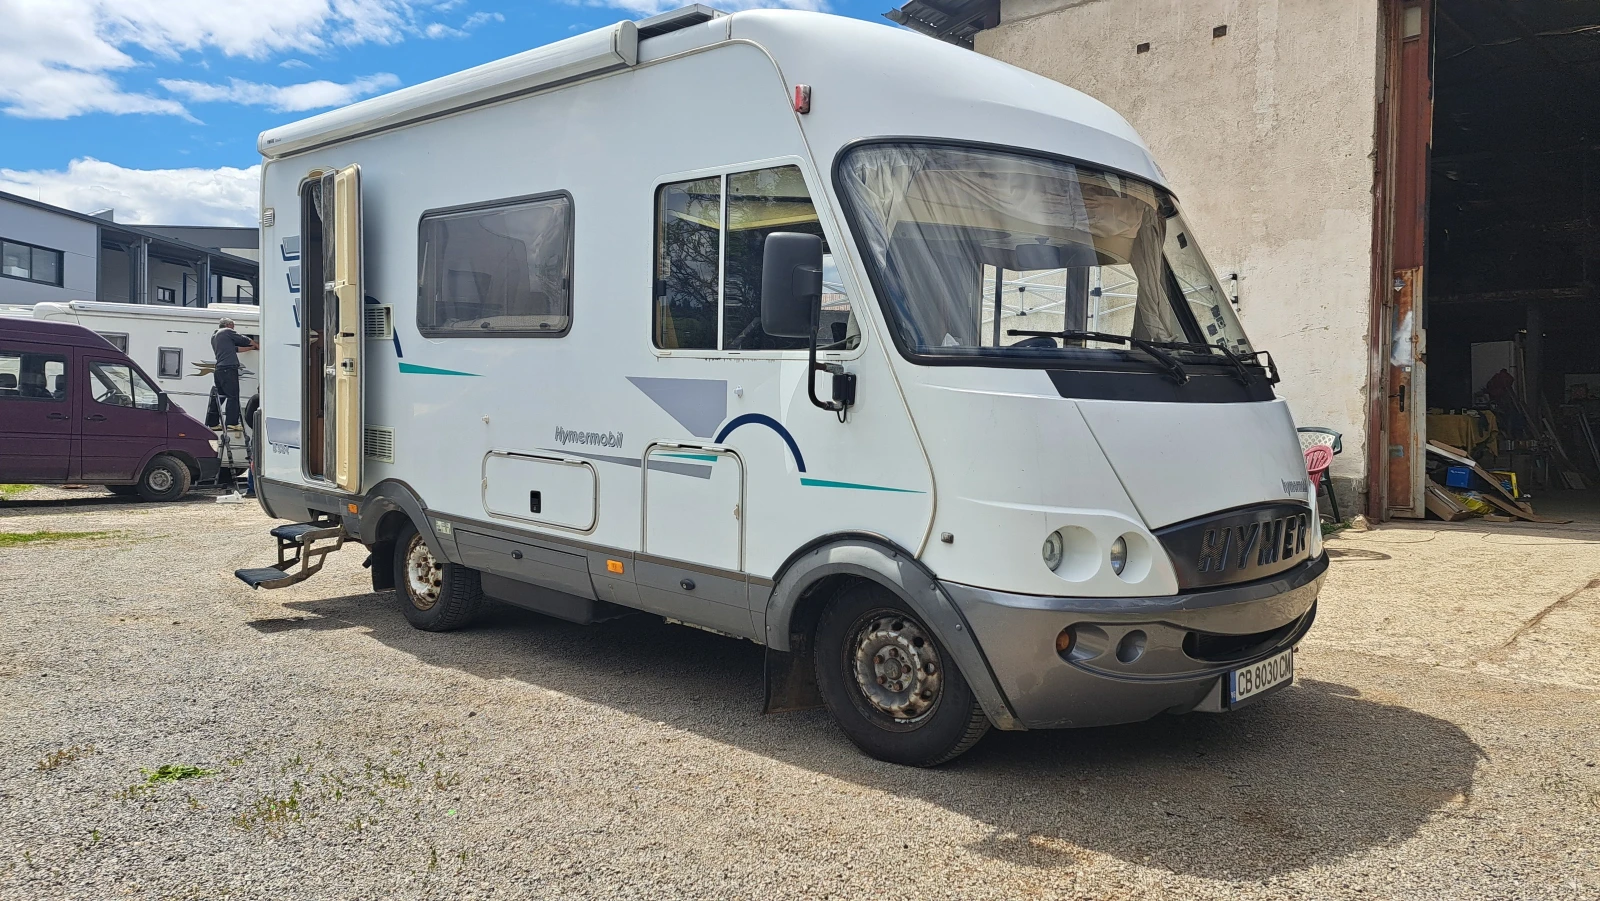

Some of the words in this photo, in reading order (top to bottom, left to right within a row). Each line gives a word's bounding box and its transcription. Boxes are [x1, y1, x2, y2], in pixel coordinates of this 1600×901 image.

[555, 426, 623, 448] Hymermobil
[1198, 513, 1306, 572] HYMER
[1238, 669, 1252, 696] CB
[1255, 659, 1278, 689] 8030
[1280, 652, 1290, 678] CM
